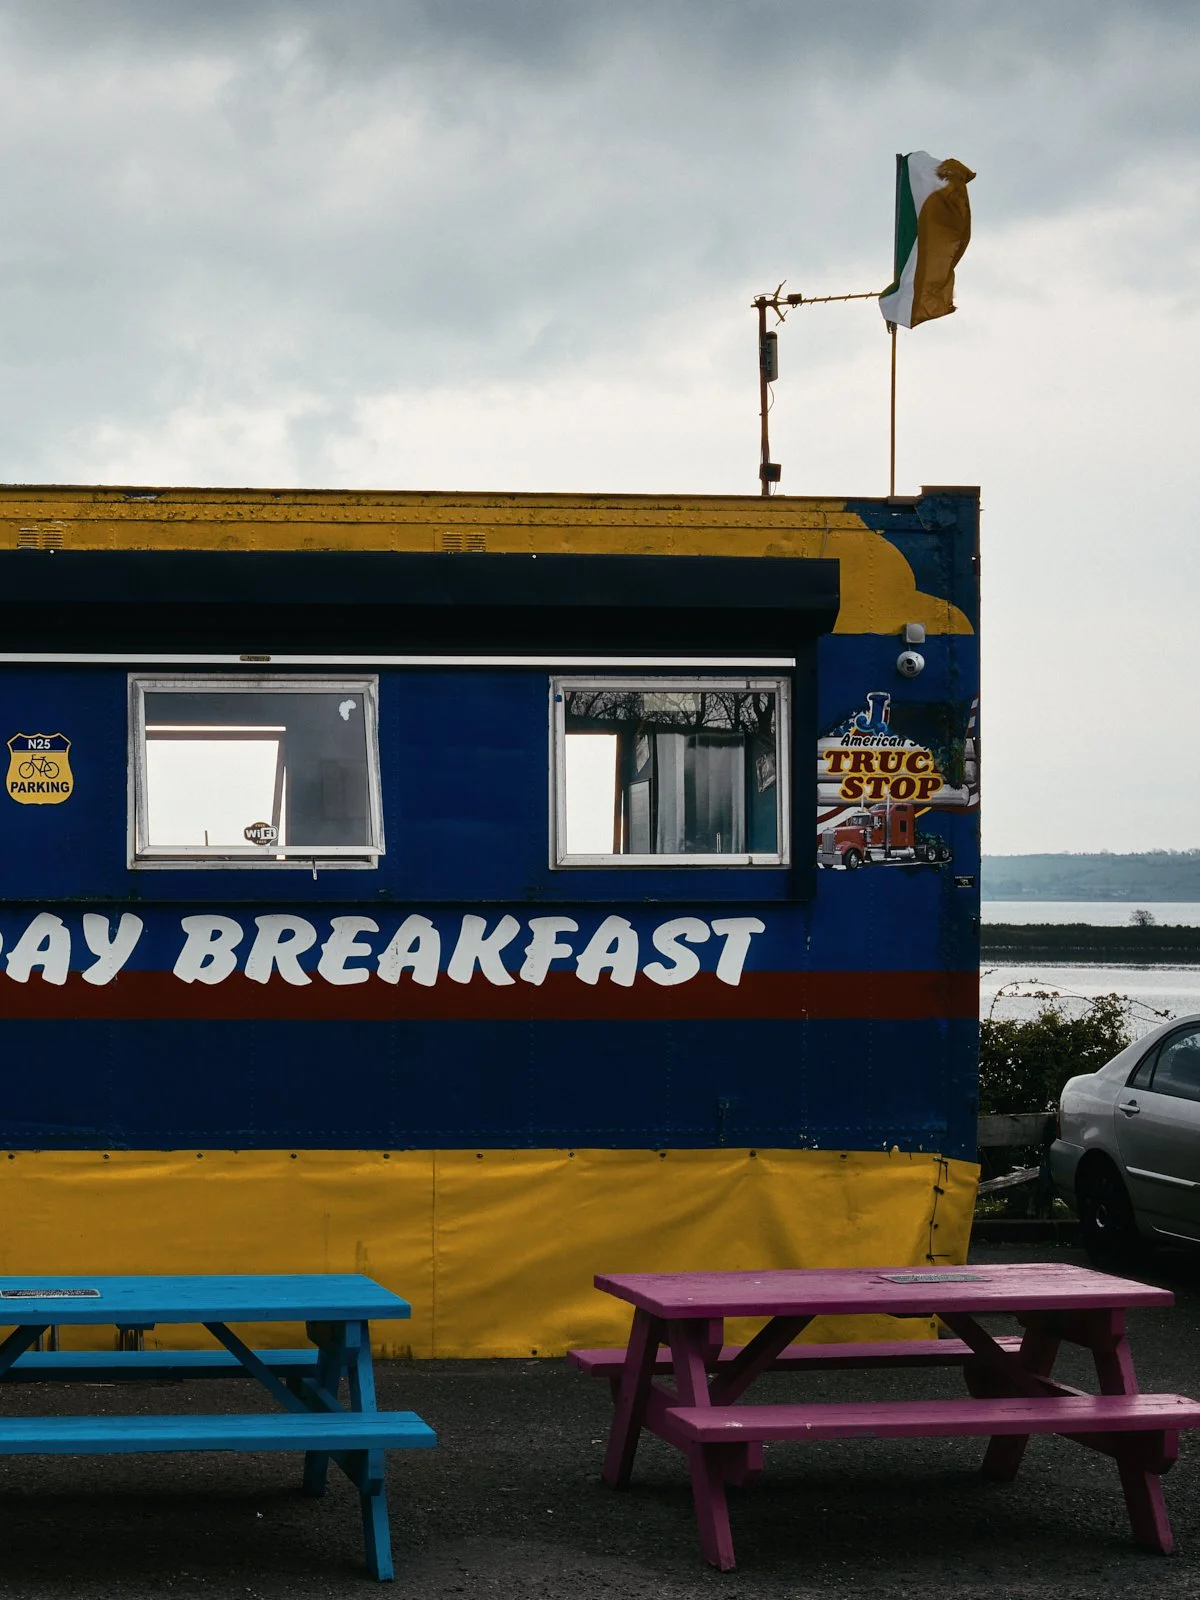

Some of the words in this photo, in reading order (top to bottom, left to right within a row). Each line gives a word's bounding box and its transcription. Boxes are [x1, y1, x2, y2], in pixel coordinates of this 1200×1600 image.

[27, 738, 51, 750] N25
[825, 750, 943, 774] TRUC
[10, 781, 71, 794] PARKING
[841, 776, 943, 801] STOP
[245, 828, 275, 838] WiFi
[173, 914, 766, 986] BREAKFAST
